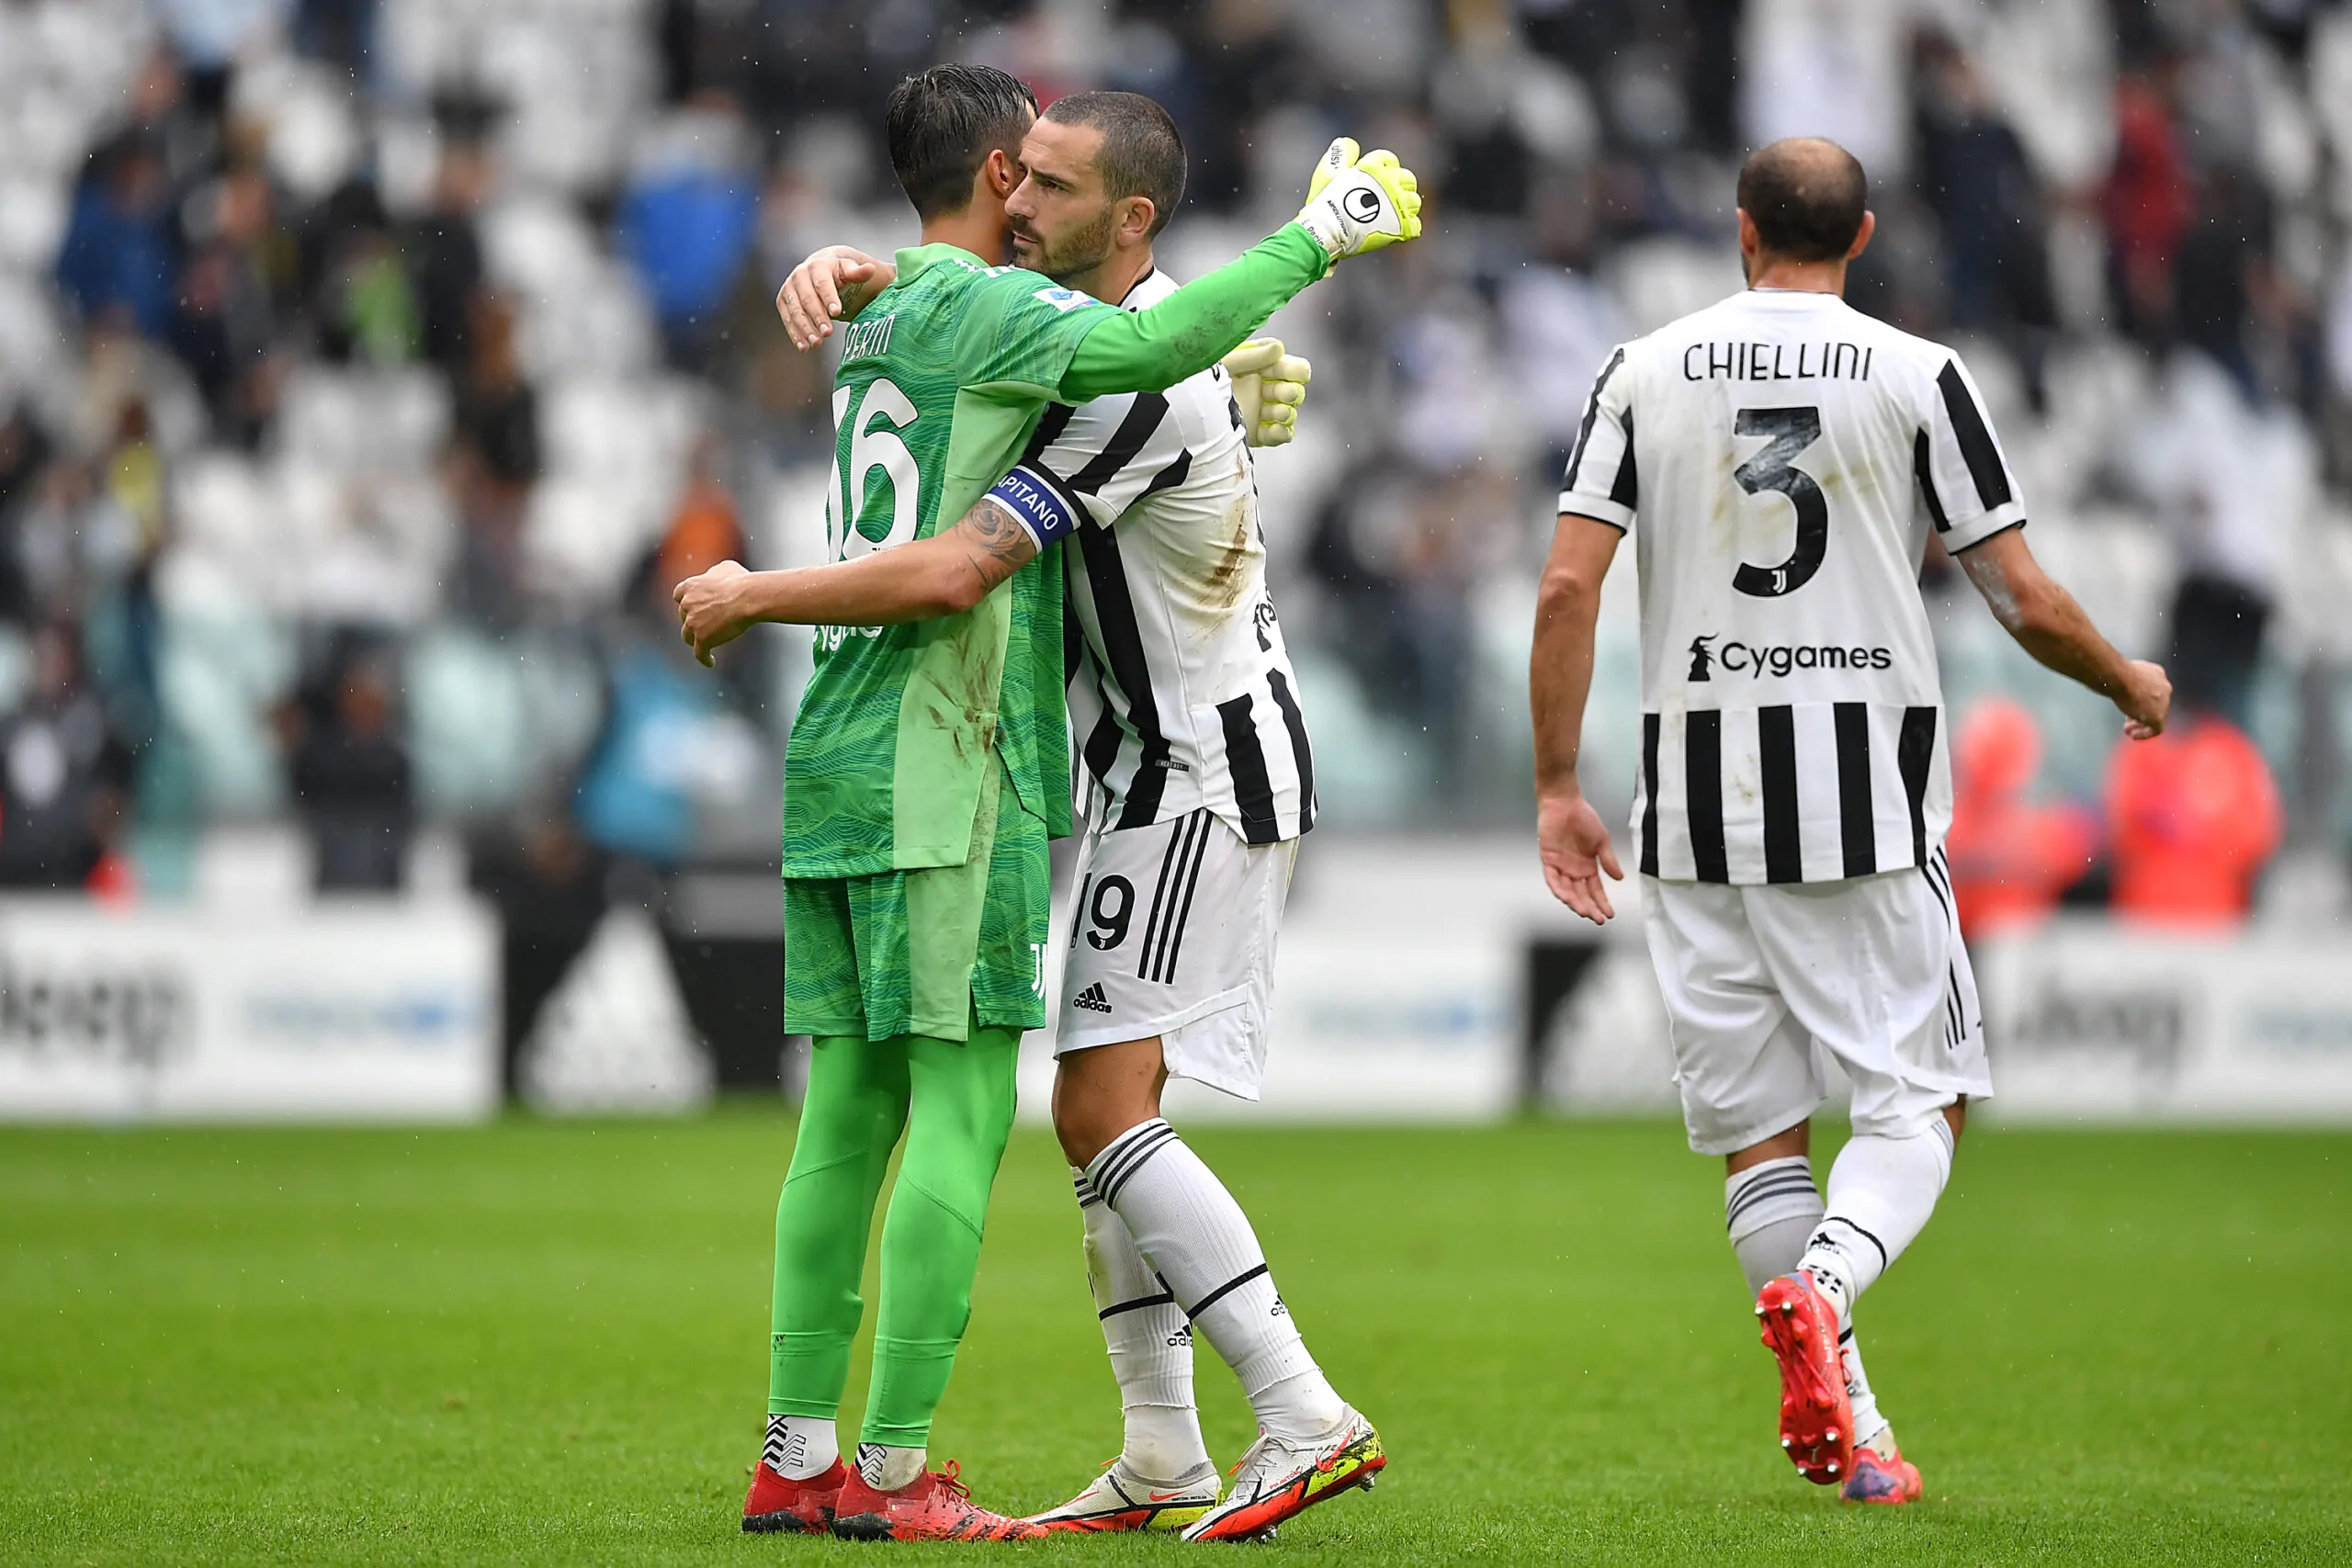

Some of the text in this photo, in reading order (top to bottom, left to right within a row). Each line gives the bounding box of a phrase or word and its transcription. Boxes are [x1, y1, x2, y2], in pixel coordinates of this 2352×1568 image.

[1683, 342, 1872, 381] CHIELLINI
[1733, 406, 1829, 598] 3
[1720, 641, 1892, 679] Cygames
[1069, 872, 1136, 952] 19
[1073, 998, 1113, 1014] adidas
